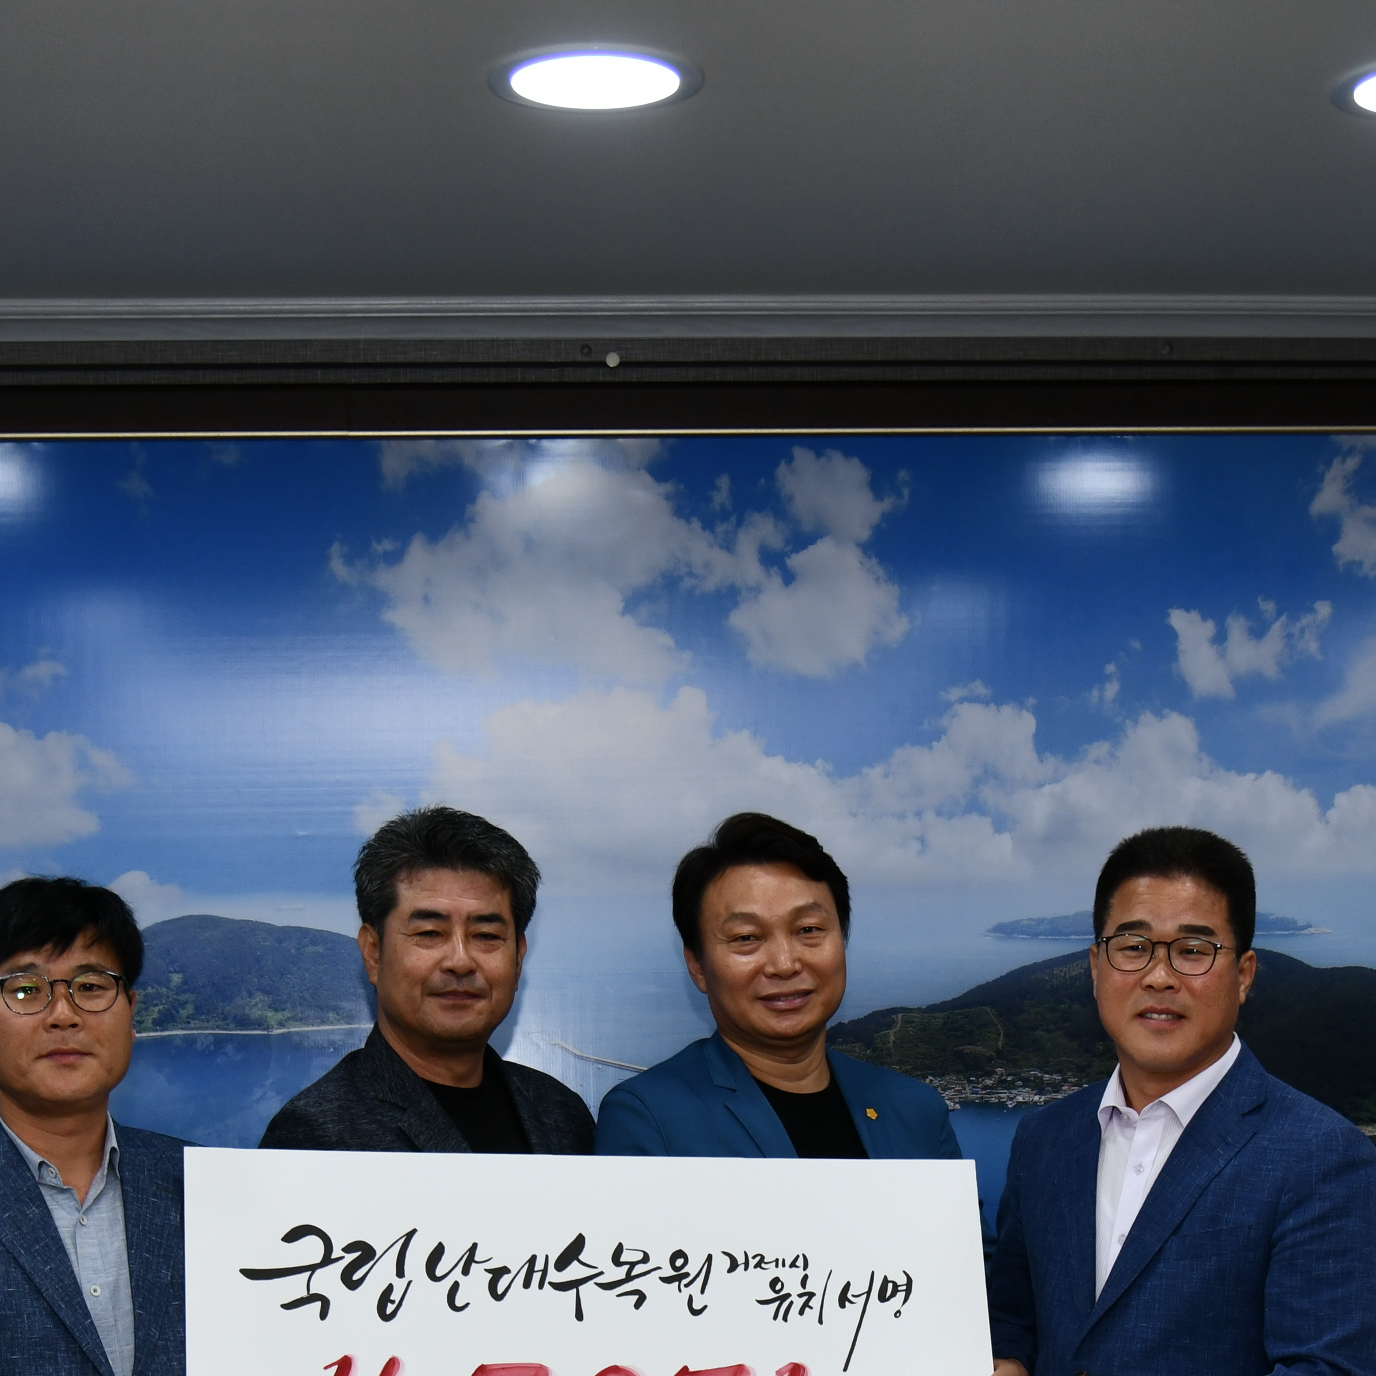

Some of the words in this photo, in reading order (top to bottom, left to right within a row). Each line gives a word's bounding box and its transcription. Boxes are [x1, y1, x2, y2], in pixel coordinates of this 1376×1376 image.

[720, 1250, 810, 1274] 거제시
[755, 1269, 833, 1326] 유치
[837, 1270, 914, 1373] 서명
